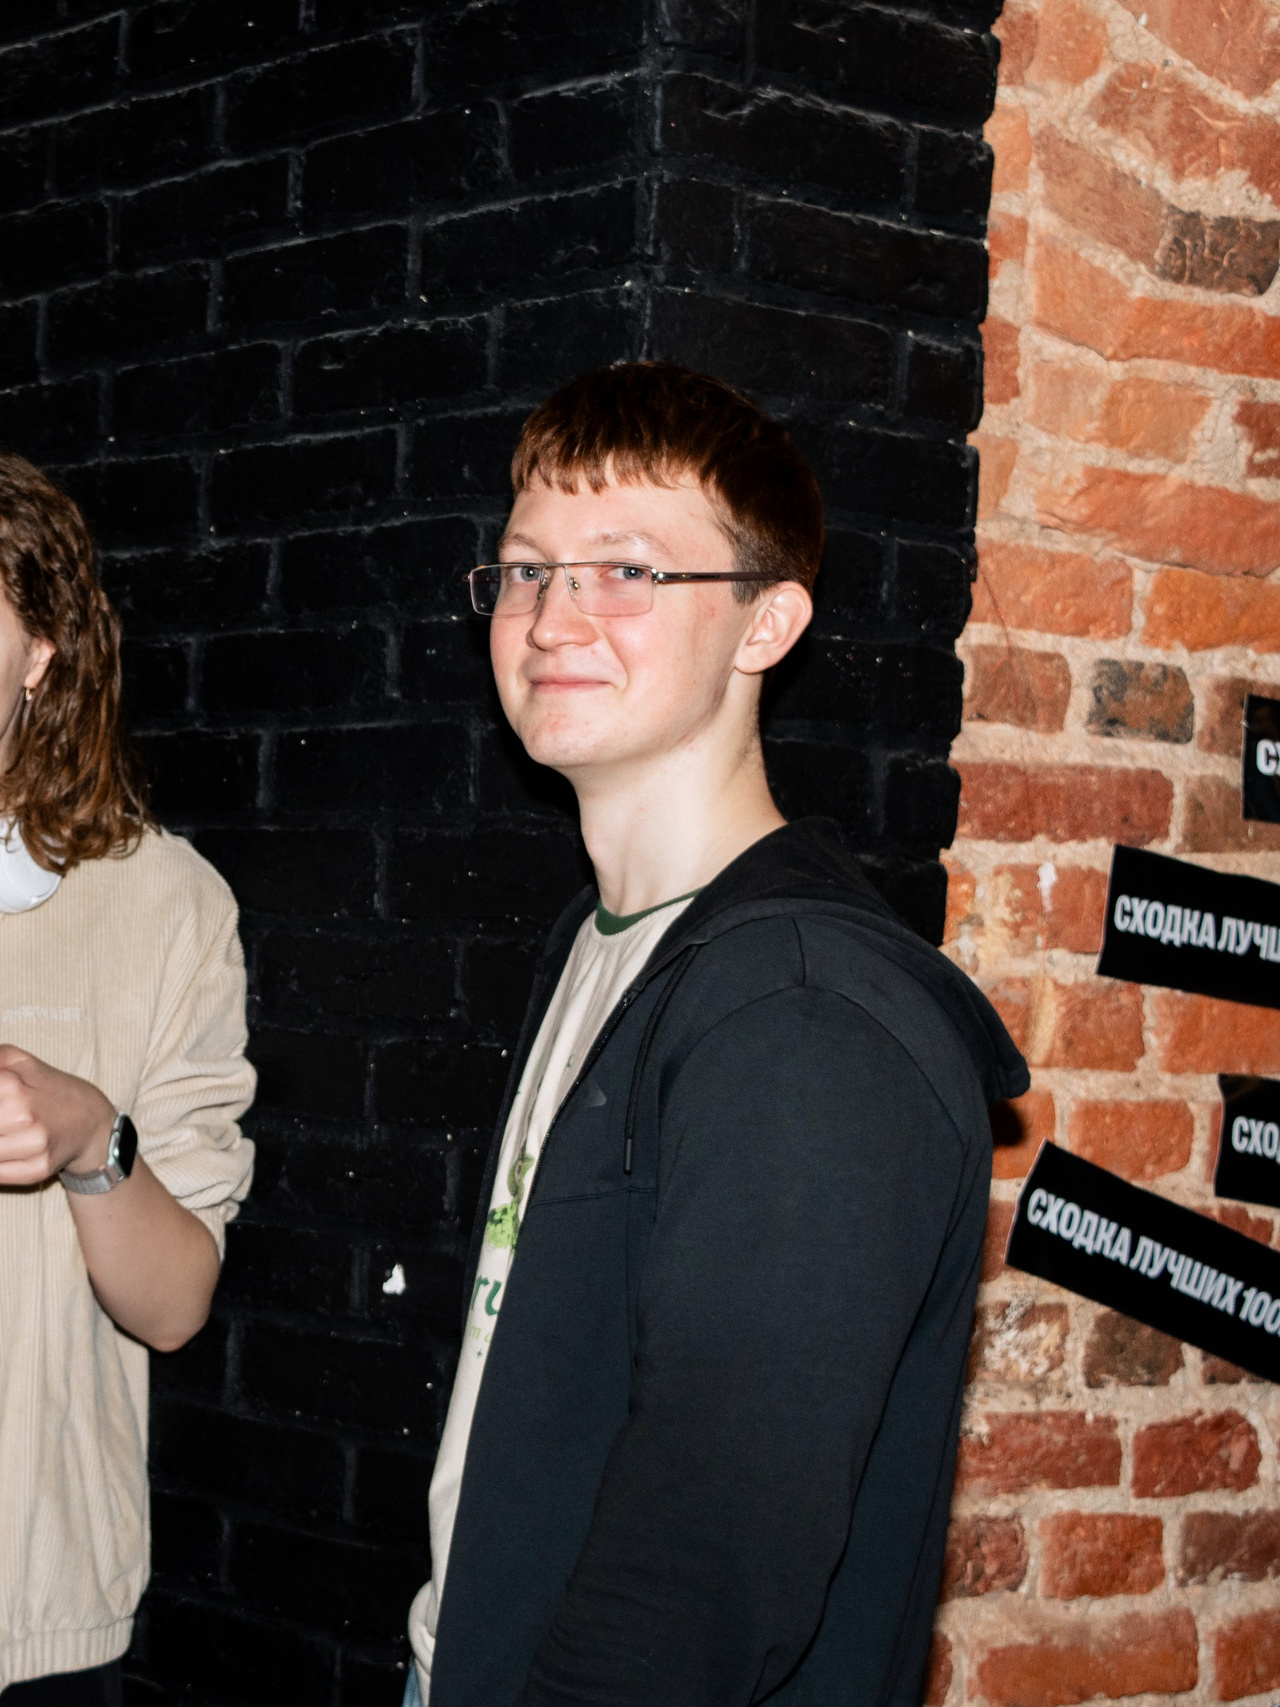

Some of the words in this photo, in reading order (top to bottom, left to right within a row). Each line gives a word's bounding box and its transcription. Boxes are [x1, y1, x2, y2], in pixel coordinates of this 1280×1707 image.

[1114, 894, 1216, 950] СХОДКА
[1231, 1115, 1280, 1165] СХО
[1027, 1187, 1132, 1267] СХОДКА
[1128, 1235, 1244, 1316] ЛУЧШИХ
[1239, 1286, 1280, 1338] 100
